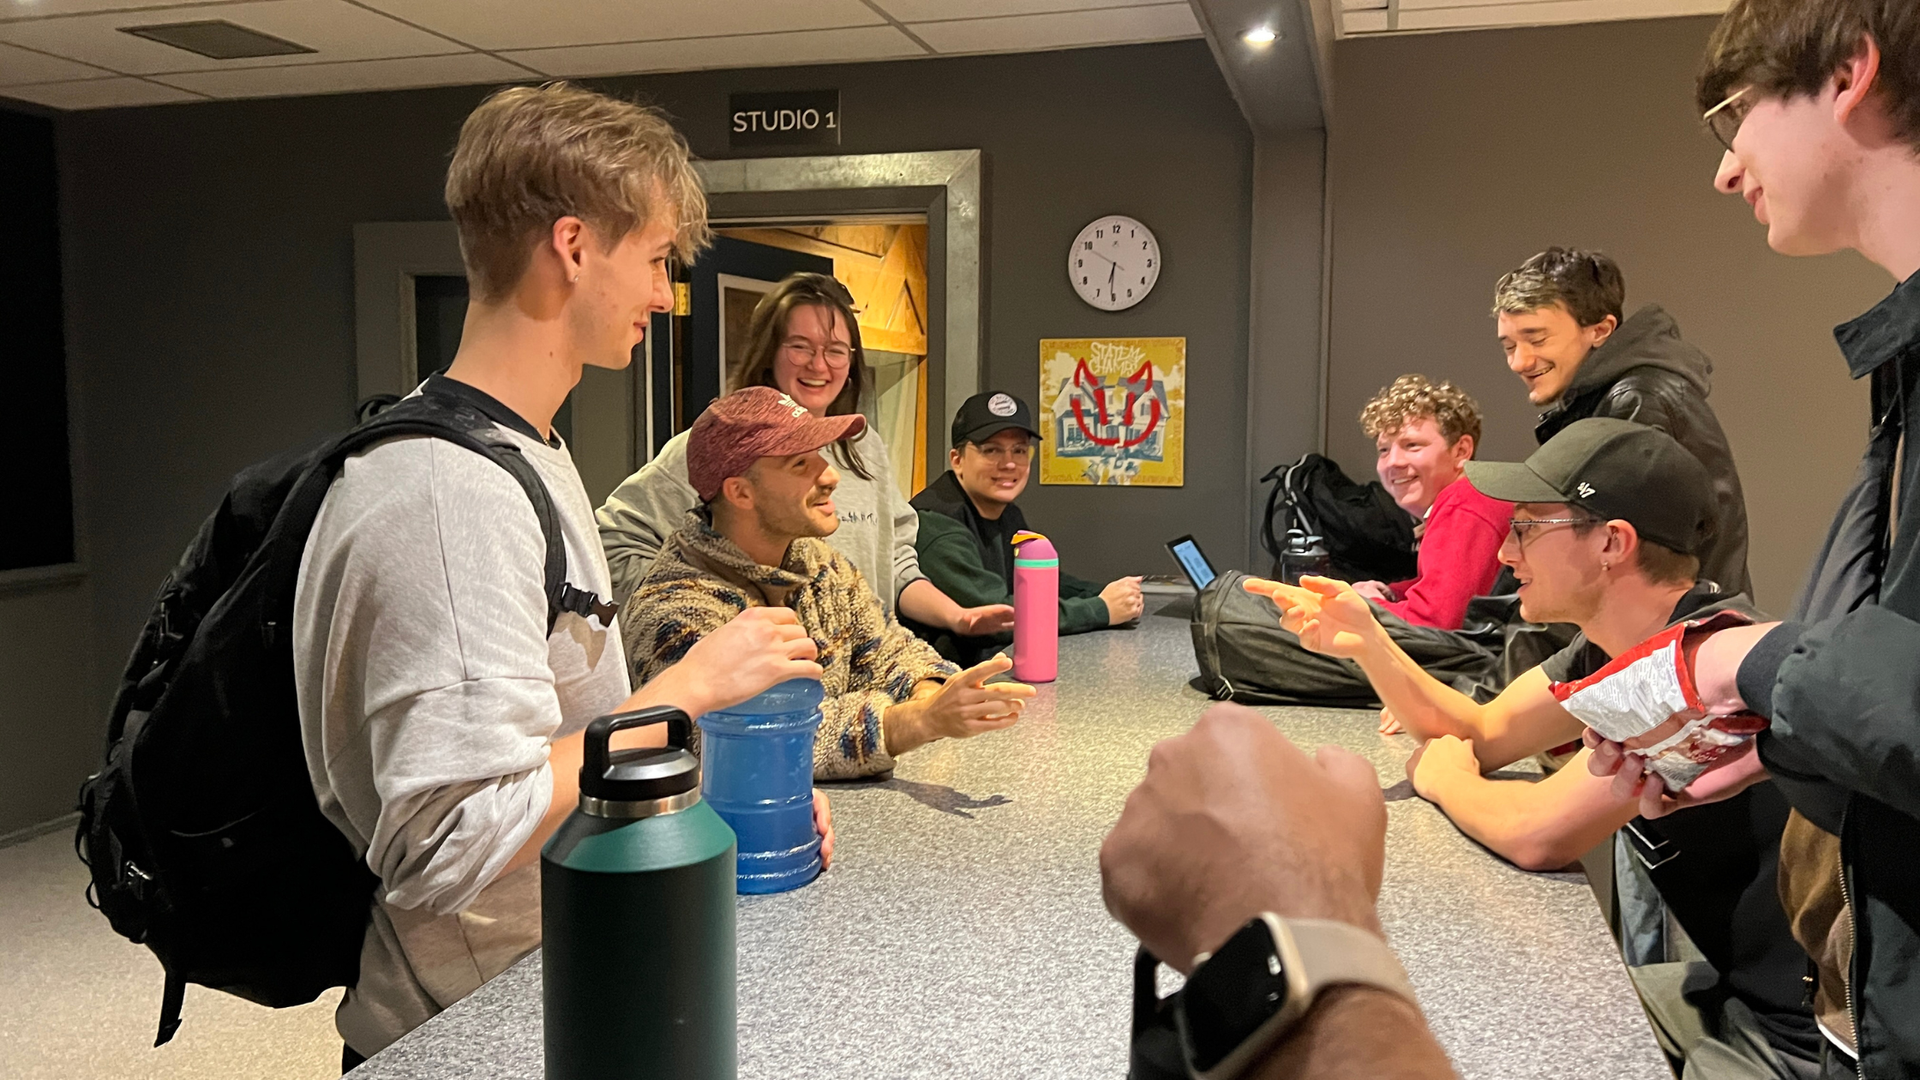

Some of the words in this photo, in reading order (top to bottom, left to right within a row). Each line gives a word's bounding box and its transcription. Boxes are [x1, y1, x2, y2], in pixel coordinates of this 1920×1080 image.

[733, 108, 820, 132] STUDIO
[825, 111, 837, 128] 1
[1096, 229, 1104, 239] 11
[1112, 225, 1121, 234] 12
[1130, 229, 1135, 239] 1
[1084, 241, 1093, 251] 10
[1142, 241, 1148, 250] 2
[1077, 259, 1083, 268] 9
[1146, 259, 1152, 268] 3
[1082, 276, 1088, 286] 8
[1140, 276, 1146, 286] 4
[1096, 288, 1101, 298] 7
[1111, 293, 1117, 302] 6
[1126, 288, 1133, 298] 5
